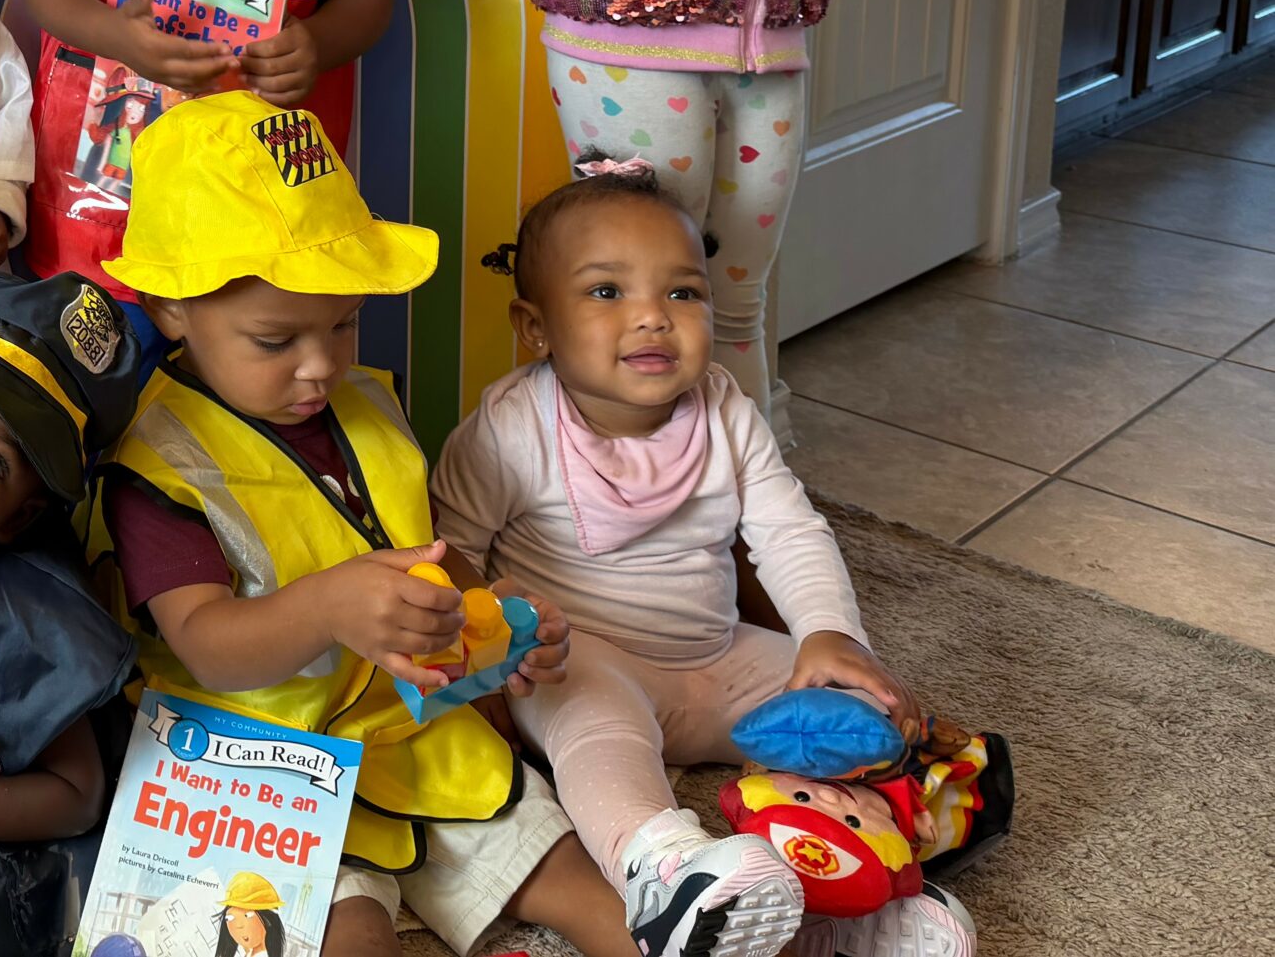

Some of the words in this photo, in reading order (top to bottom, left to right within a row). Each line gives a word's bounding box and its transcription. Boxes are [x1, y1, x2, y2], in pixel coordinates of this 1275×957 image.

[188, 0, 207, 20] to
[213, 6, 238, 32] Be
[246, 24, 260, 39] a
[69, 318, 101, 360] 2088
[214, 716, 226, 725] MY
[230, 721, 287, 739] COMMUNITY
[180, 727, 195, 752] 1
[212, 739, 223, 758] I
[226, 743, 265, 761] Can
[269, 745, 327, 773] Read!
[155, 759, 164, 777] I
[170, 761, 223, 796] Want
[231, 778, 251, 797] to
[257, 783, 283, 809] Be
[292, 795, 318, 814] an
[133, 780, 322, 867] Engineer
[118, 856, 146, 870] pictures
[147, 864, 156, 874] by
[157, 867, 185, 881] Catalina
[186, 875, 220, 890] Echeverri
[121, 843, 131, 854] by
[131, 846, 152, 860] Laura
[152, 853, 180, 867] Driscoll
